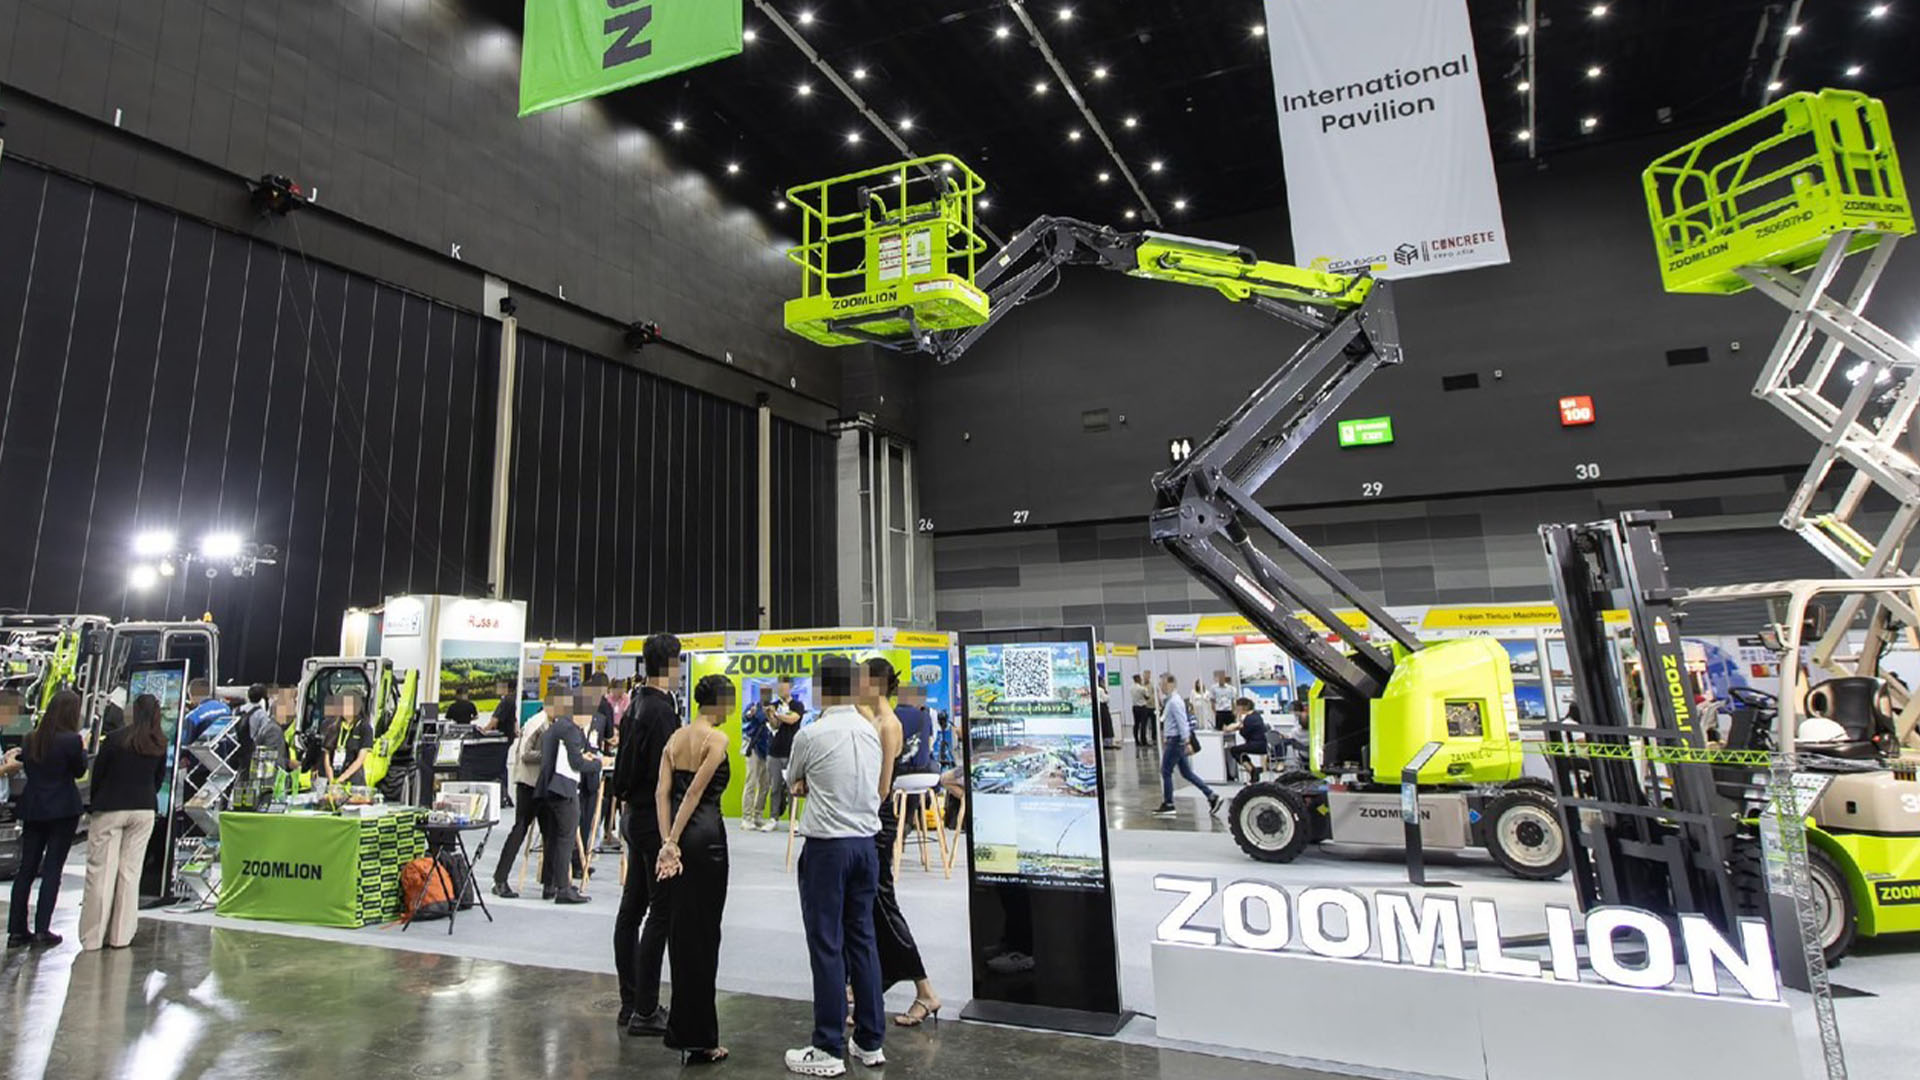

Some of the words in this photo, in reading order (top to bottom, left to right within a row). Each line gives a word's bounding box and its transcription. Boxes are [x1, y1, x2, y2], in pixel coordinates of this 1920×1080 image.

[1282, 54, 1469, 113] International
[1321, 97, 1436, 133] Pavilion
[307, 187, 317, 203] J
[1843, 200, 1905, 213] ZOOMLION
[1431, 231, 1495, 251] CONCRETE
[451, 243, 462, 260] K
[1668, 241, 1729, 272] ZOOMLION
[559, 285, 566, 300] L
[832, 291, 898, 310] ZOOMLION
[1564, 408, 1591, 421] 100
[1575, 463, 1600, 480] 30
[1362, 482, 1384, 496] 29
[918, 518, 934, 531] 26
[1013, 510, 1029, 524] 27
[467, 615, 499, 629] Russa
[724, 652, 857, 675] ZOOMLI
[1662, 654, 1692, 760] ZOOMLI
[1359, 807, 1431, 820] ZOOMLN
[241, 860, 322, 880] ZOOMLION
[1152, 873, 1780, 1002] ZOOMLION
